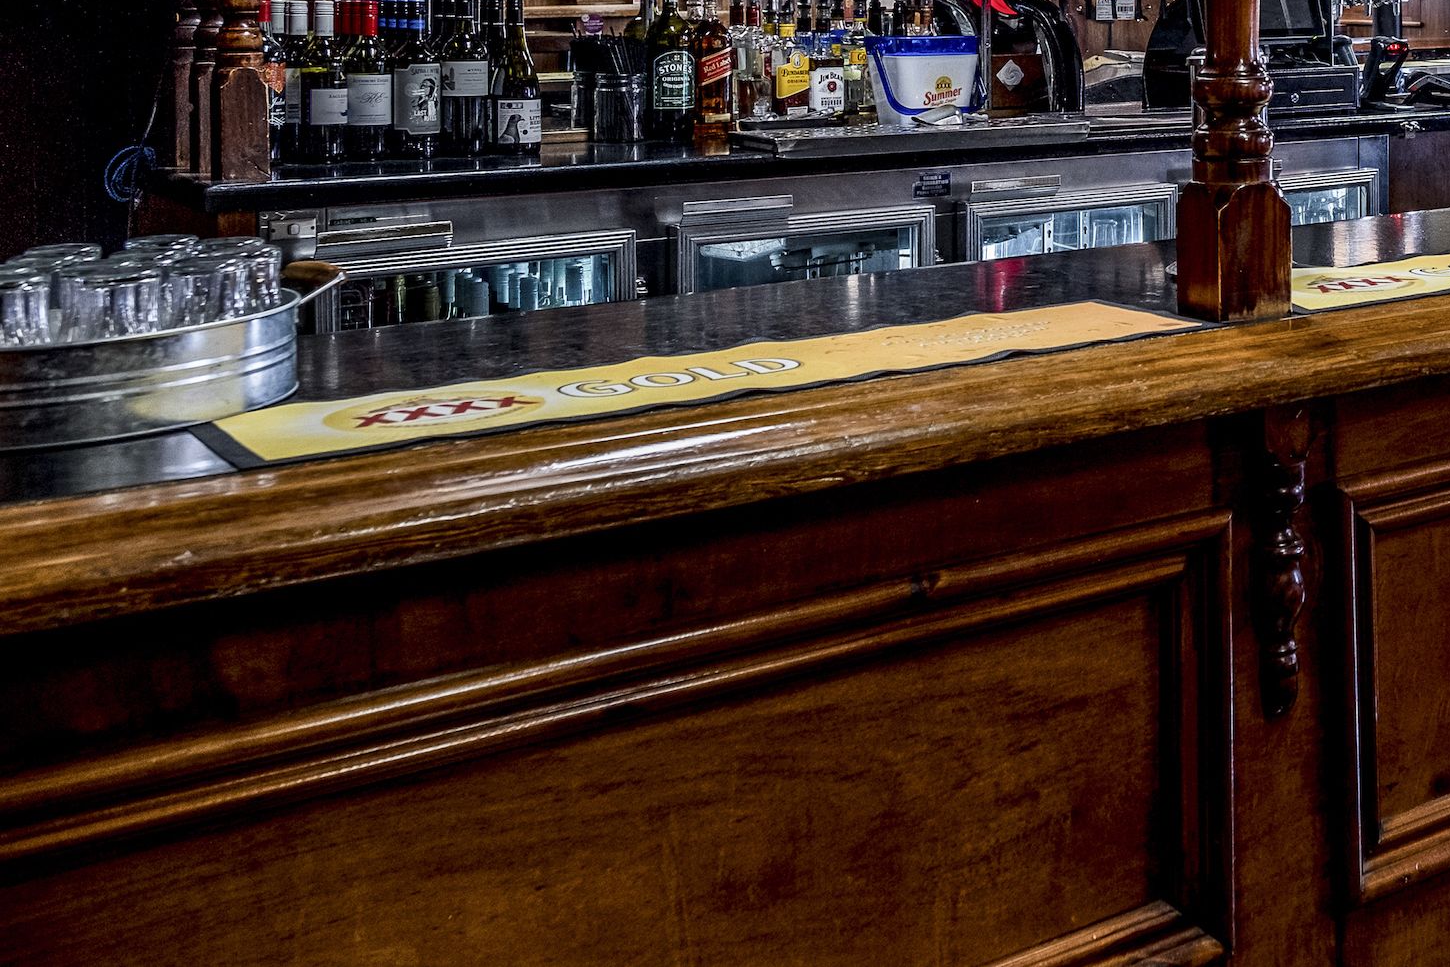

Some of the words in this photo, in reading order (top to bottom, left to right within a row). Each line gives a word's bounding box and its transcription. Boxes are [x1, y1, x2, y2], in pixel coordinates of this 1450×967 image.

[703, 62, 714, 74] Red
[715, 56, 732, 71] Label
[818, 72, 830, 84] JIM
[923, 87, 962, 106] Summer
[1314, 274, 1416, 296] XXXX
[557, 357, 803, 400] GOLD
[353, 394, 539, 429] XXXX
